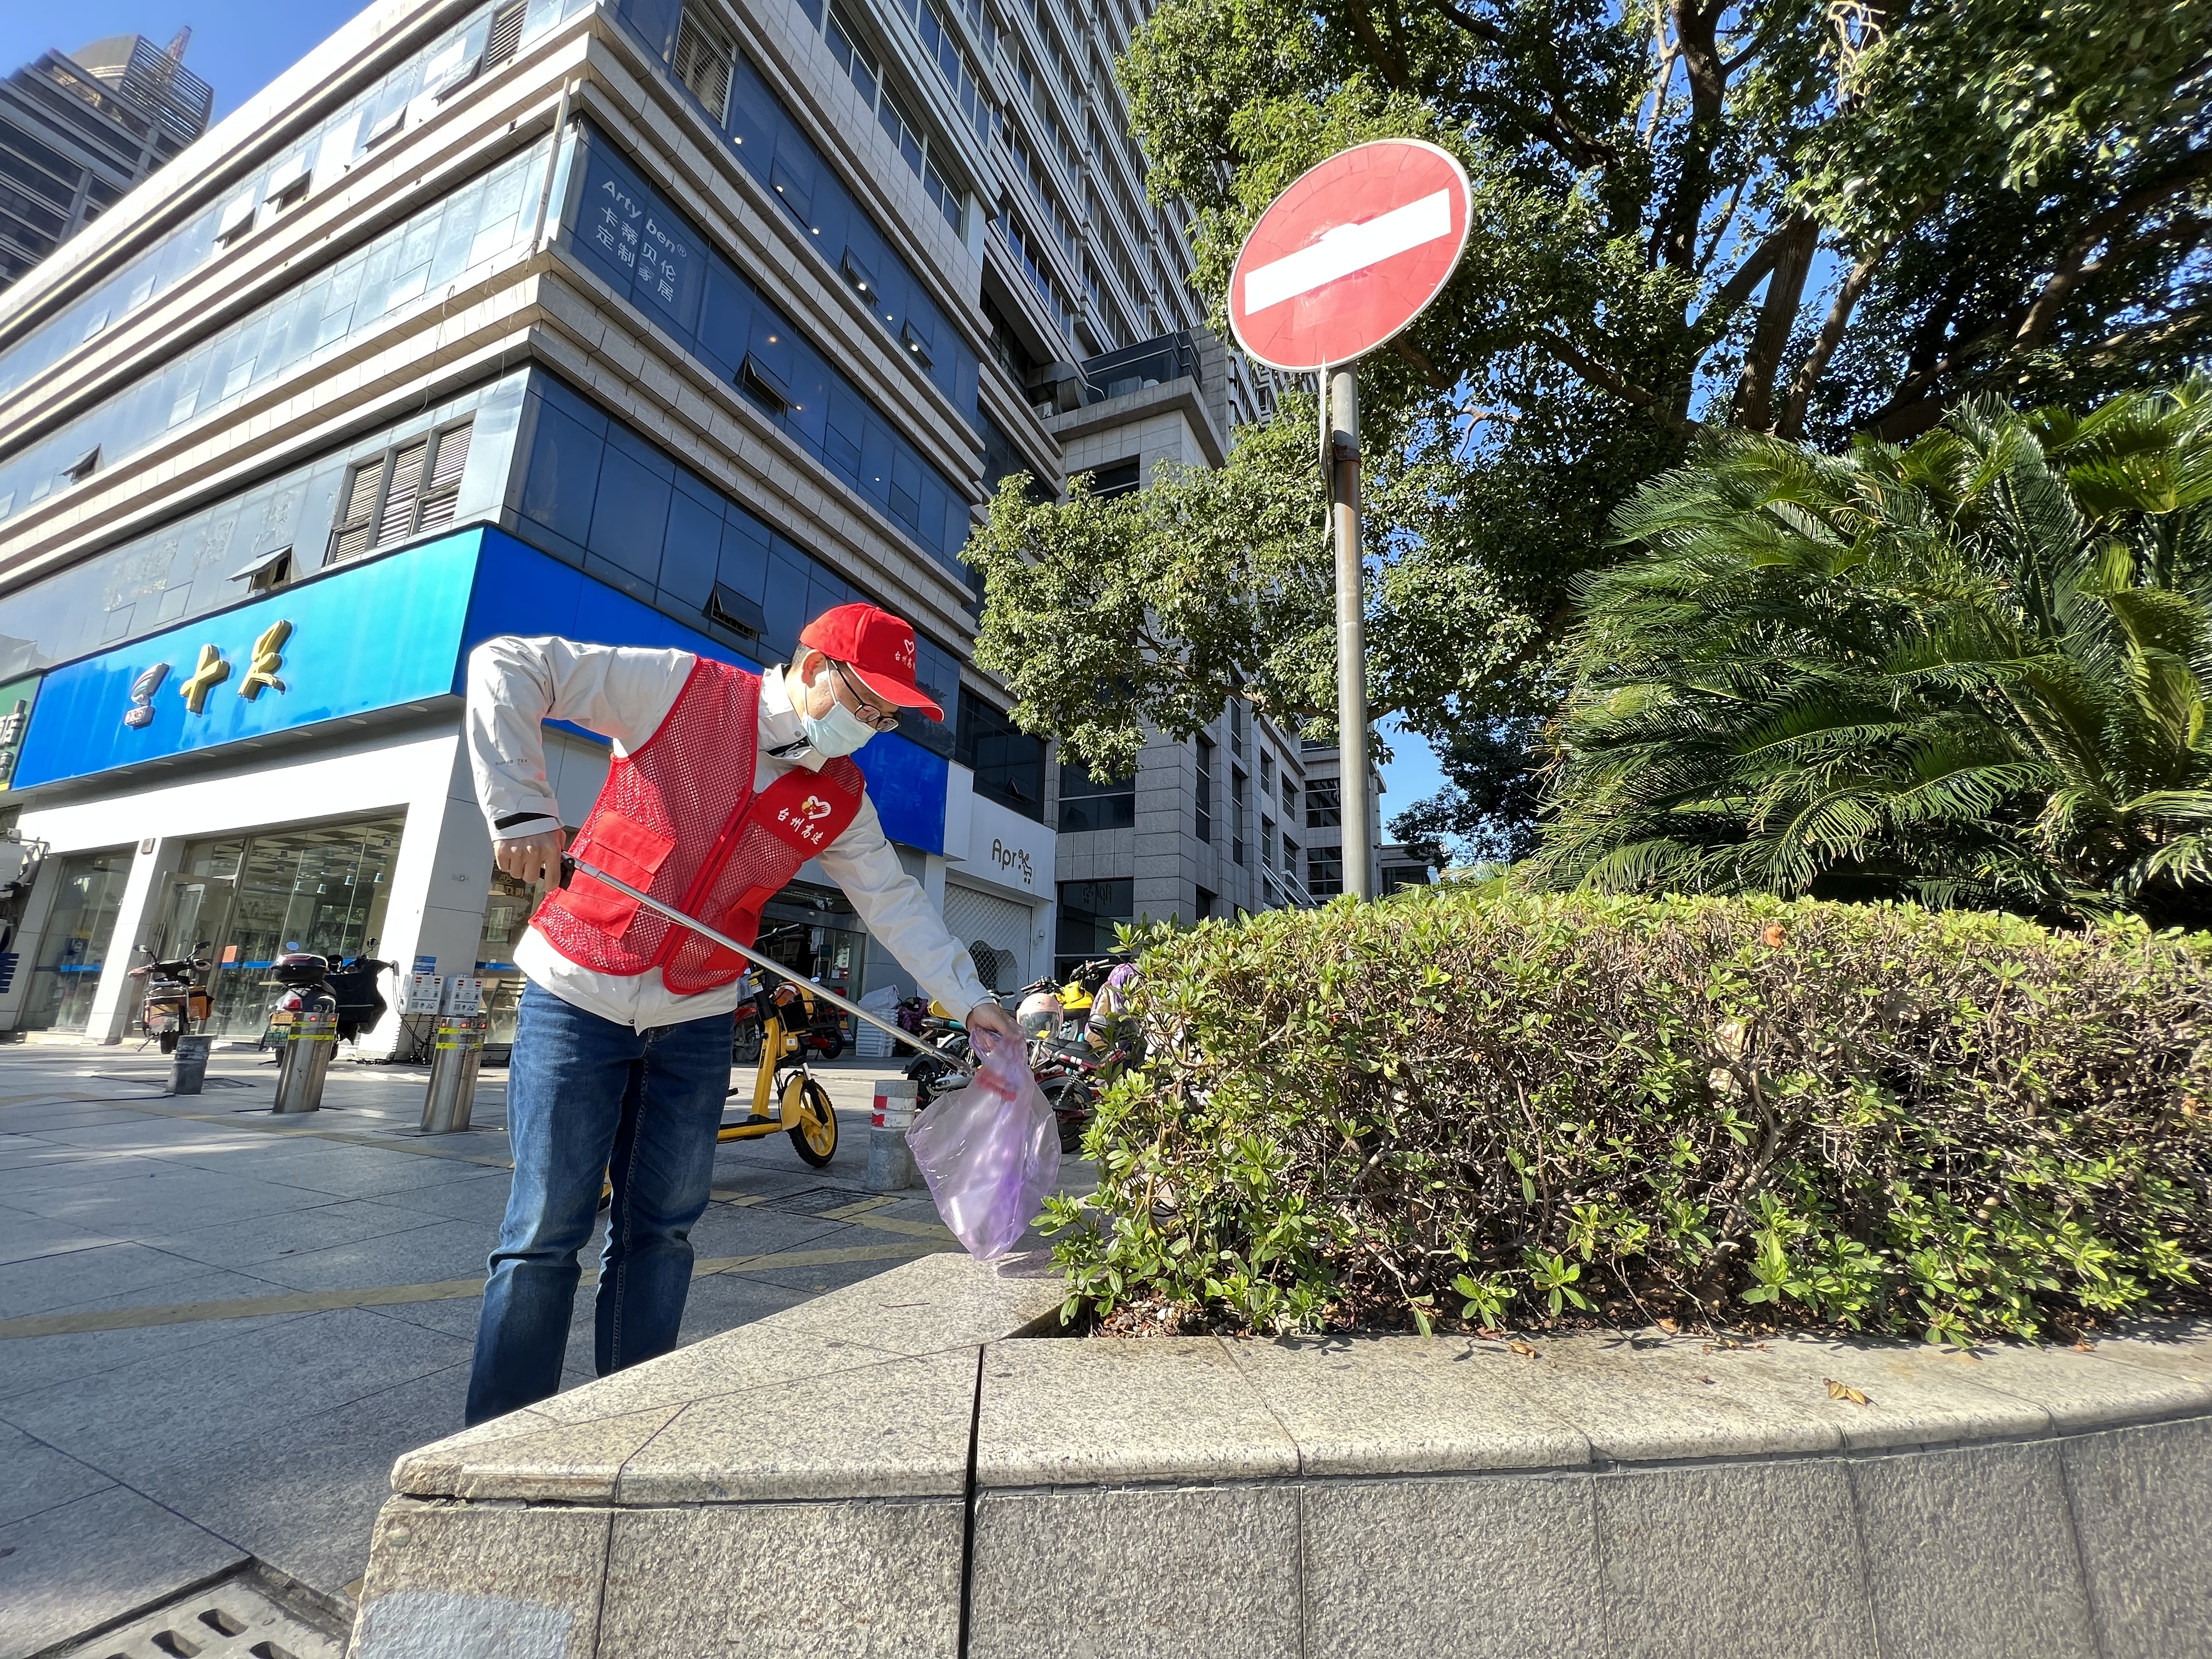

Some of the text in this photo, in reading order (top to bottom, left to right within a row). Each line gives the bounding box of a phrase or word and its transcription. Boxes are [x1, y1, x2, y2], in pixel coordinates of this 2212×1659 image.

[601, 180, 642, 219] Arty
[595, 224, 674, 303] 定制家居
[601, 206, 676, 283] 卡蒂贝伦
[777, 807, 823, 845] 台州高速
